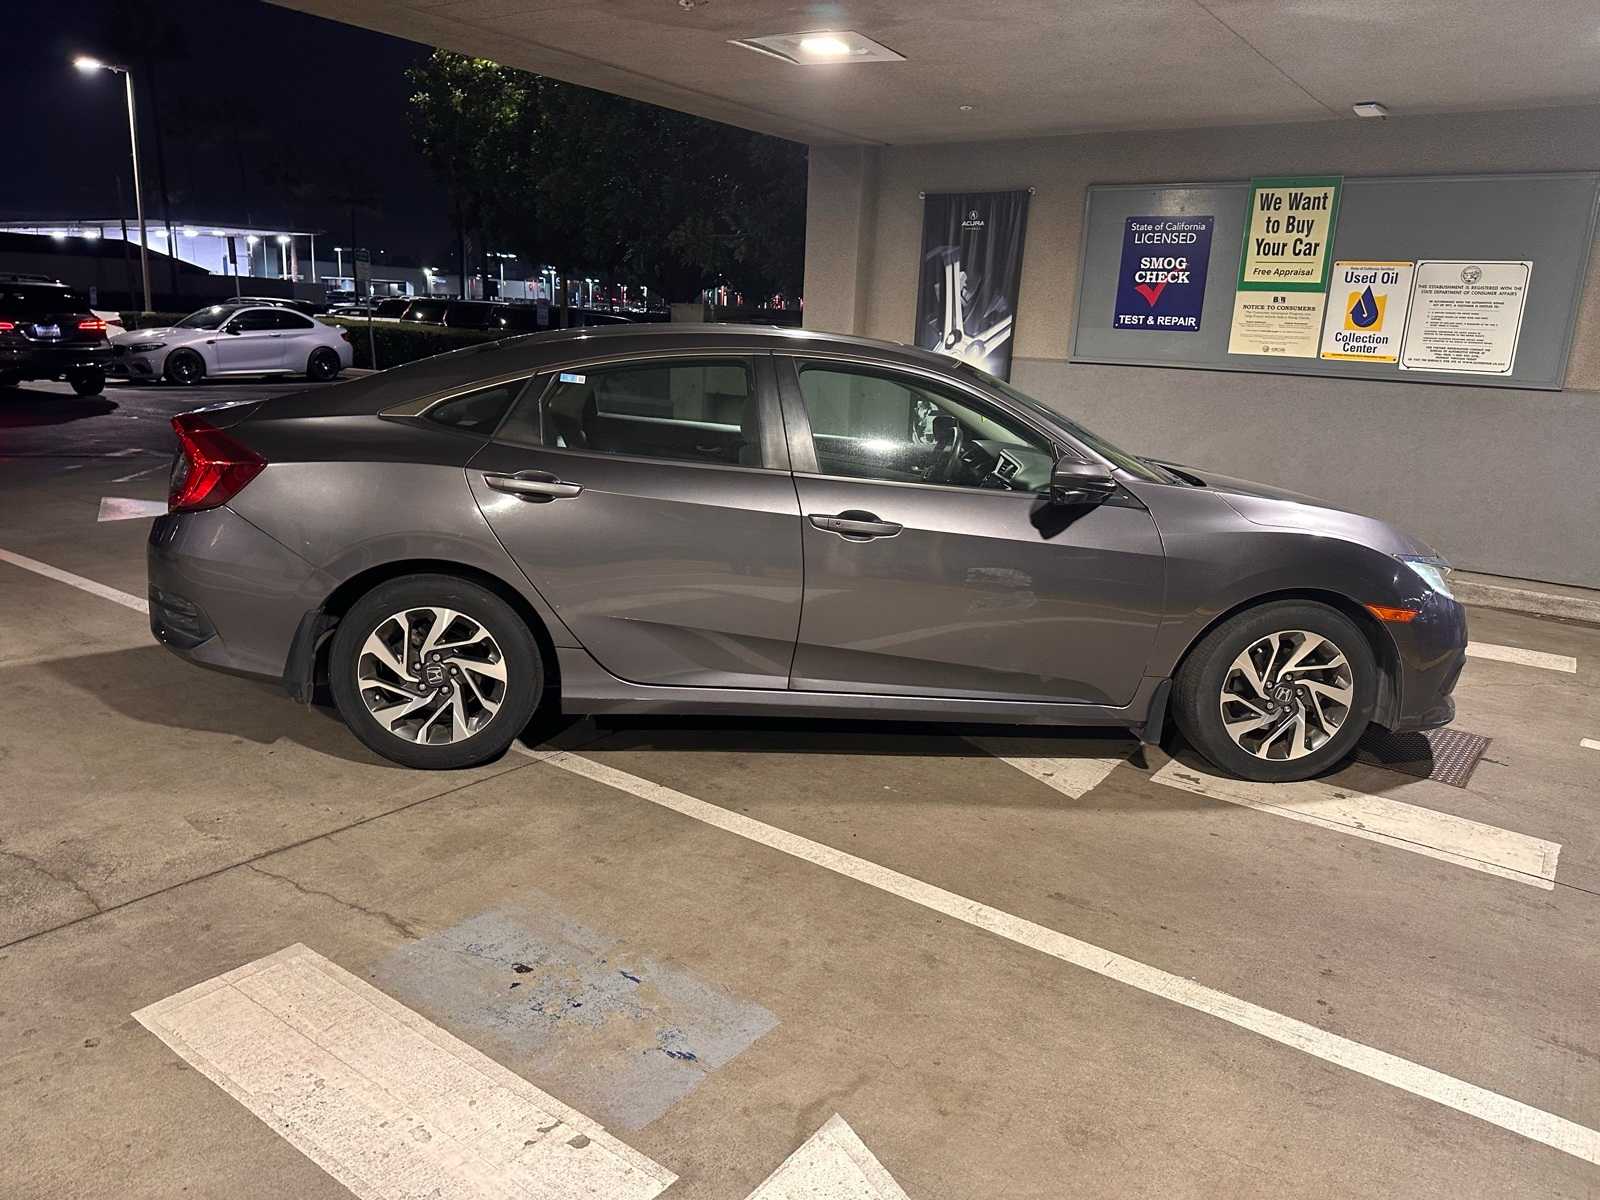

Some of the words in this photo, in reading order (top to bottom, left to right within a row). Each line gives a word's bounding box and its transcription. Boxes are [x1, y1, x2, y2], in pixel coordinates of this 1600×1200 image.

[1260, 193, 1282, 211] We
[1288, 192, 1328, 211] Want
[1131, 222, 1153, 231] State
[1154, 222, 1164, 231] of
[1165, 222, 1206, 231] California
[1266, 216, 1280, 234] to
[1285, 215, 1314, 238] Buy
[1134, 232, 1197, 244] LICENSED
[1256, 238, 1288, 256] Your
[1292, 237, 1320, 257] Car
[1140, 257, 1188, 270] SMOG
[1134, 271, 1190, 284] CHECK
[1253, 267, 1272, 276] Free
[1273, 267, 1314, 277] Appraisal
[1344, 271, 1378, 284] Used
[1381, 271, 1399, 285] Oil
[1119, 315, 1145, 325] TEST
[1146, 315, 1155, 325] &
[1157, 316, 1197, 327] REPAIR
[1335, 331, 1389, 345] Collection
[1342, 342, 1378, 354] Center
